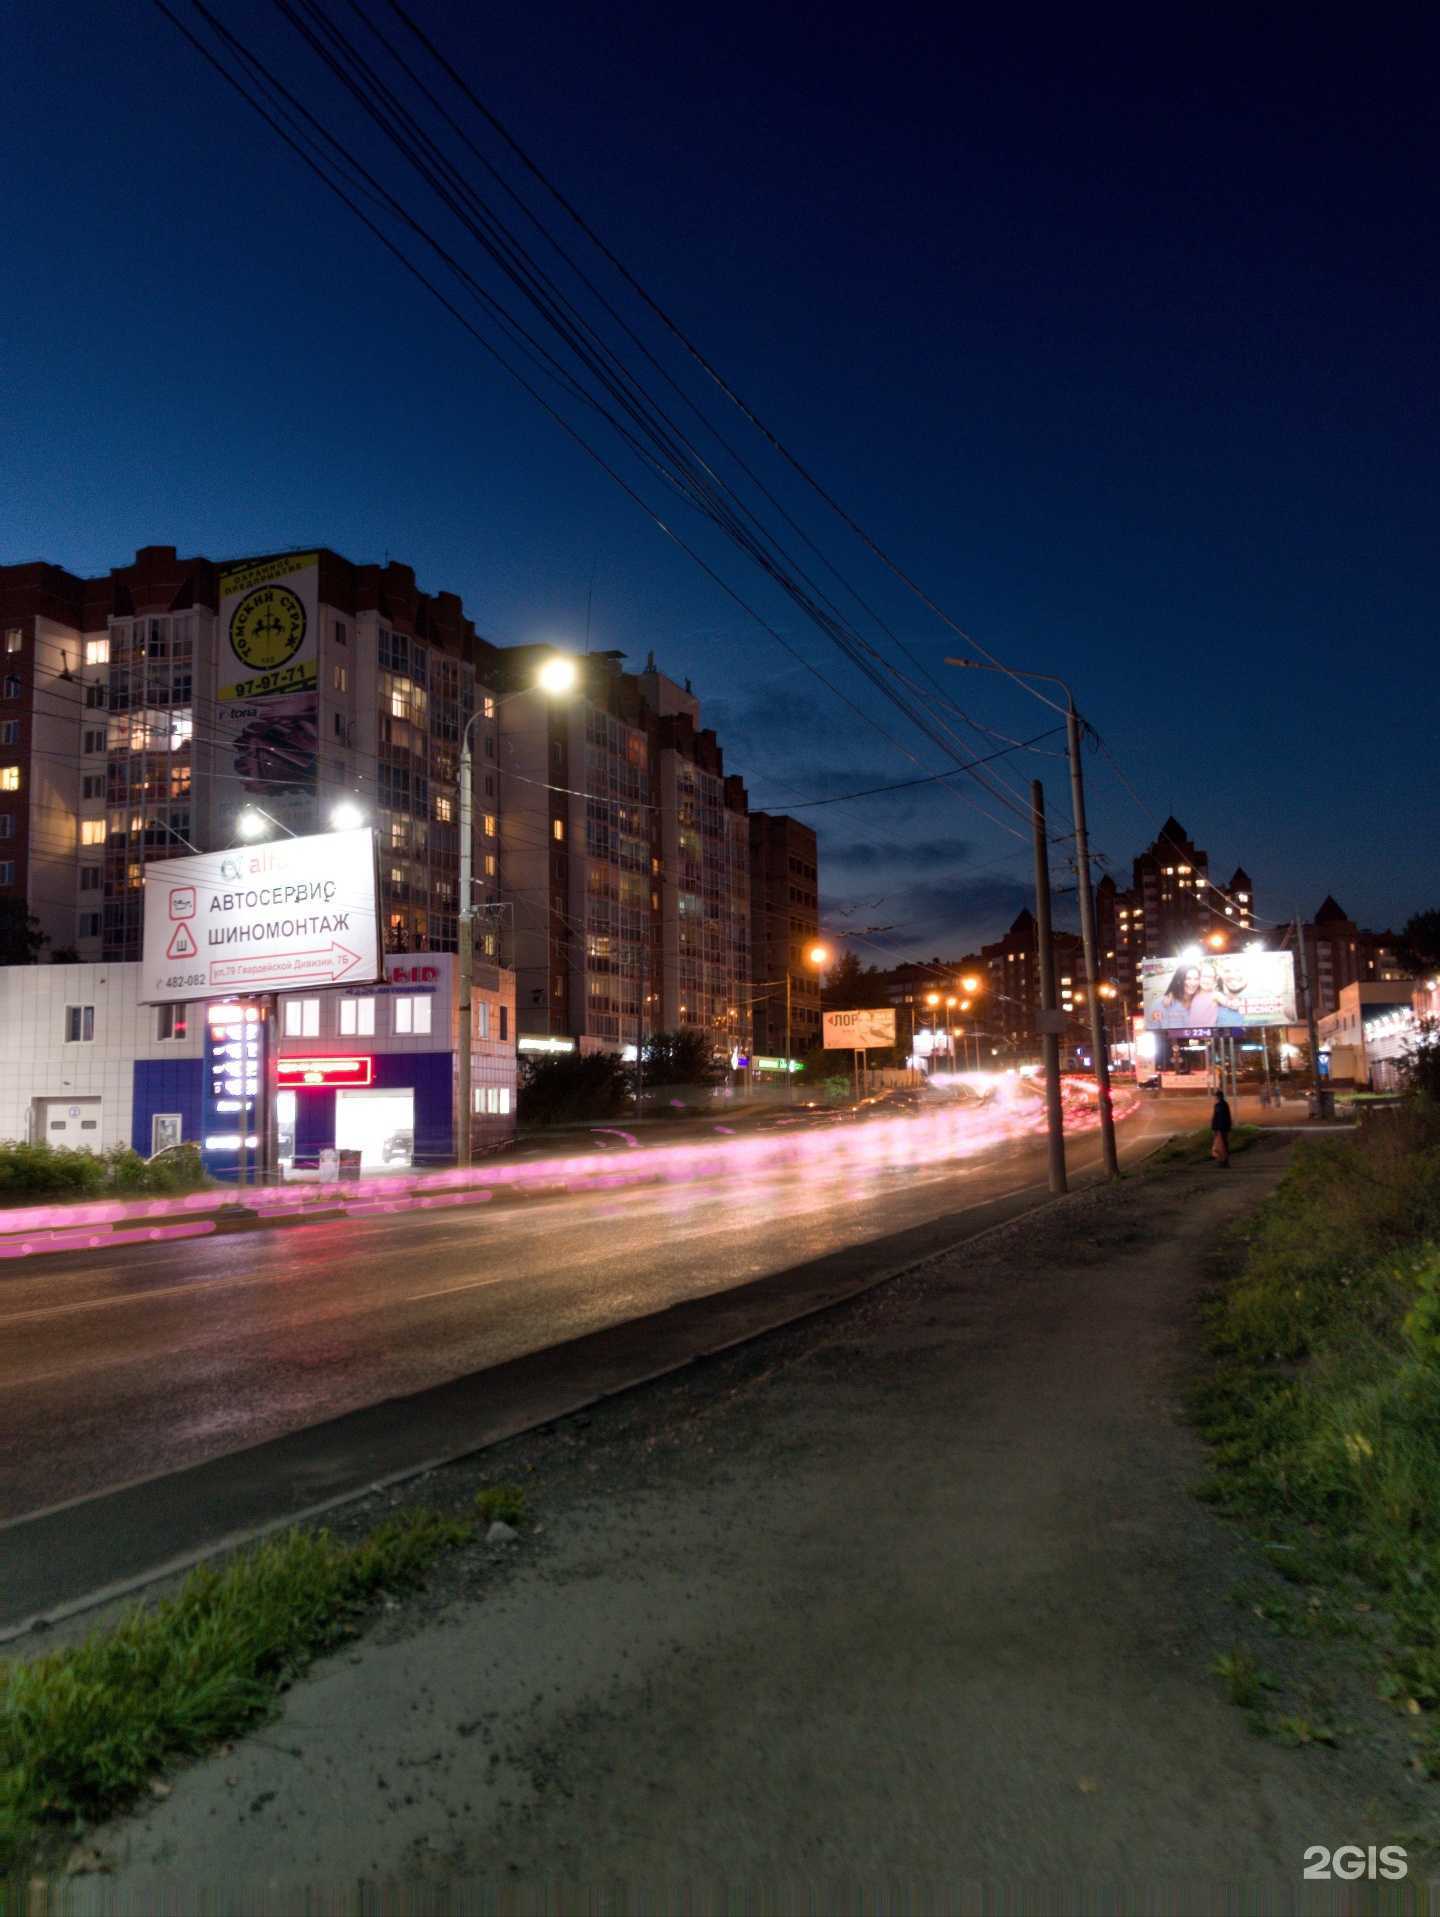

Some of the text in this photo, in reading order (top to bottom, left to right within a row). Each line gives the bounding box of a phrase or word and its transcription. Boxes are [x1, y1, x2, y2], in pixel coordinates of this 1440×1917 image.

[236, 589, 300, 658] ТОМСКИЙ СТРАЖ
[235, 664, 305, 697] 97-97-71
[209, 881, 336, 913] АВТОСЕРВИС
[208, 912, 350, 946] ШИНОМОНТАЖ
[166, 973, 206, 989] 482-082
